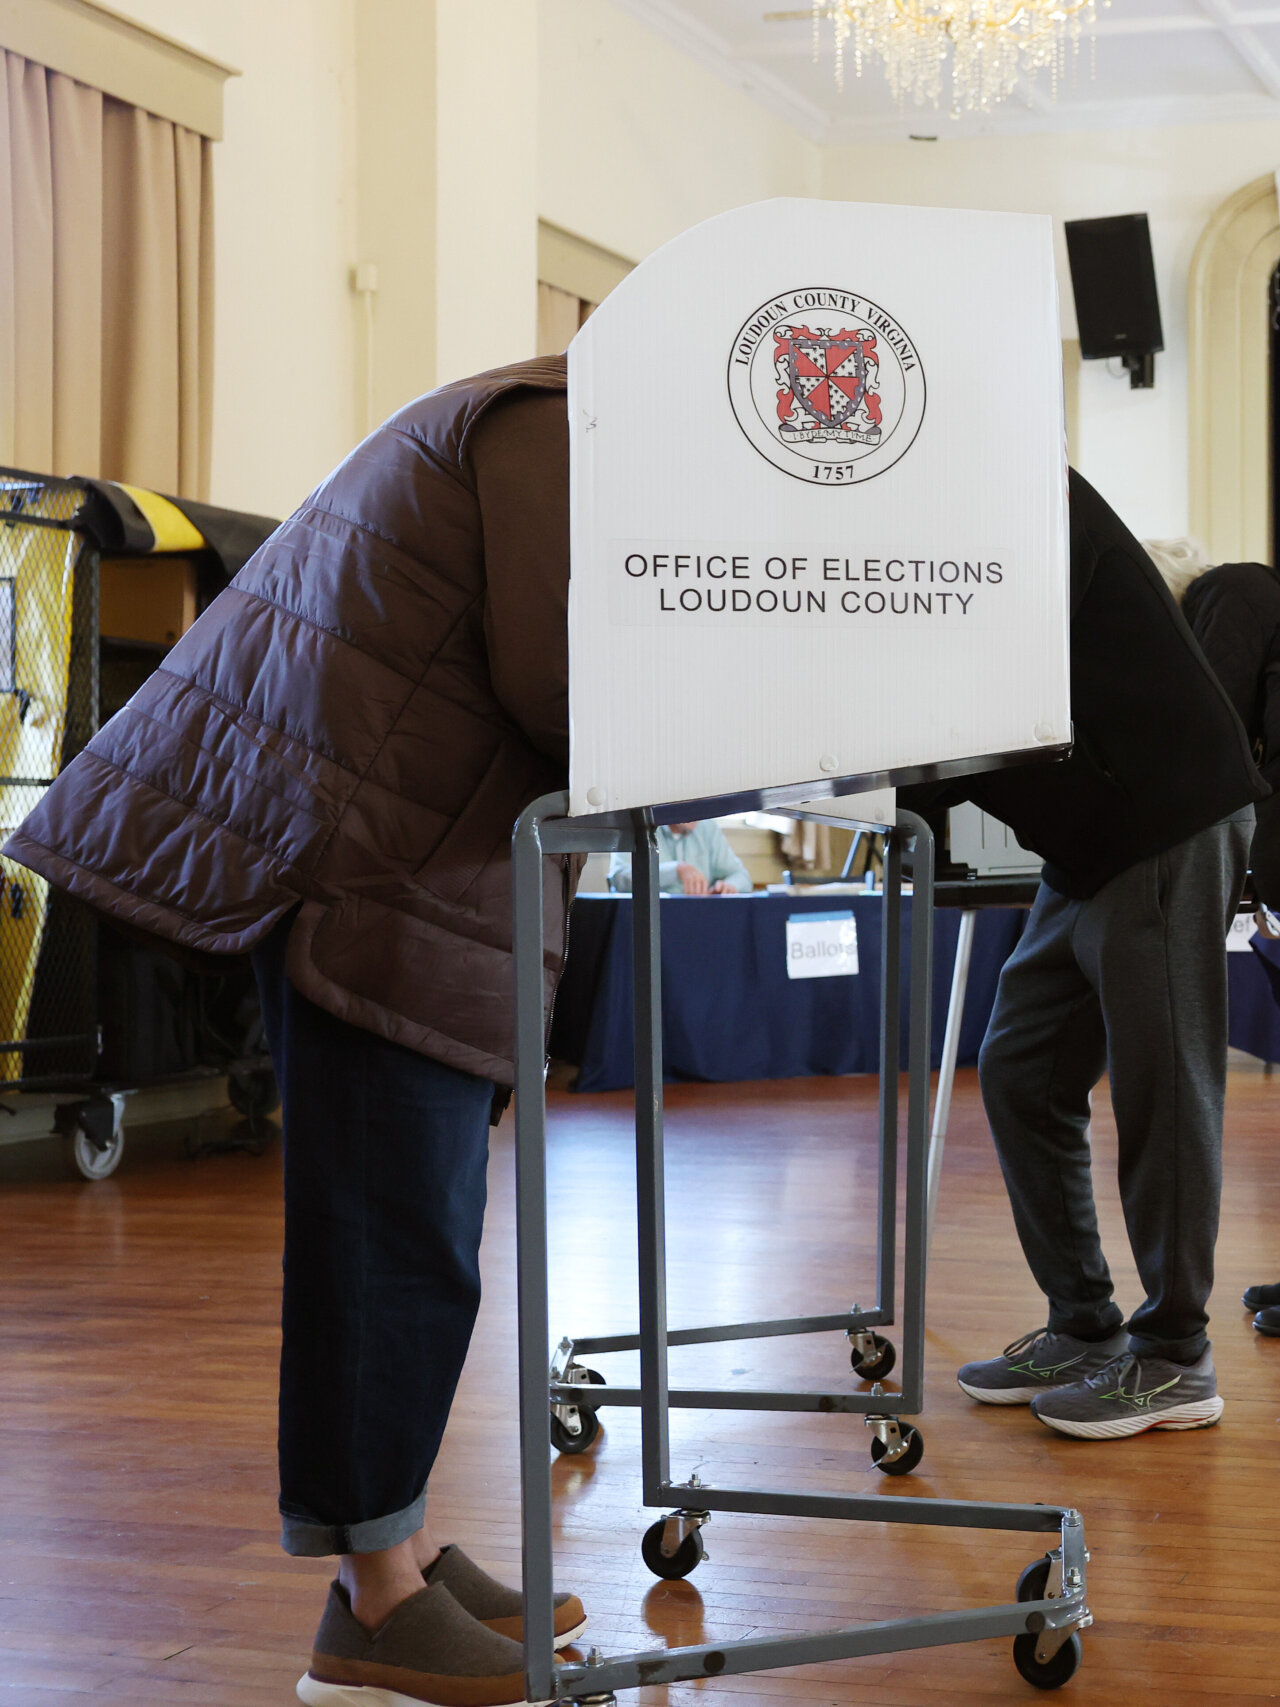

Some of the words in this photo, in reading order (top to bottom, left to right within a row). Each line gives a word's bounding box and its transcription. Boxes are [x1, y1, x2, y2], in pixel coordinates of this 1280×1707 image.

[735, 301, 788, 366] LOUDOUN
[793, 292, 861, 313] COUNTY
[867, 307, 916, 372] VIRGINIA
[812, 465, 854, 480] 1757
[624, 554, 751, 579] OFFICE
[765, 557, 808, 580] OF
[823, 558, 1003, 584] ELECTIONS
[660, 589, 826, 613] LOUDOUN
[840, 590, 975, 615] COUNTY
